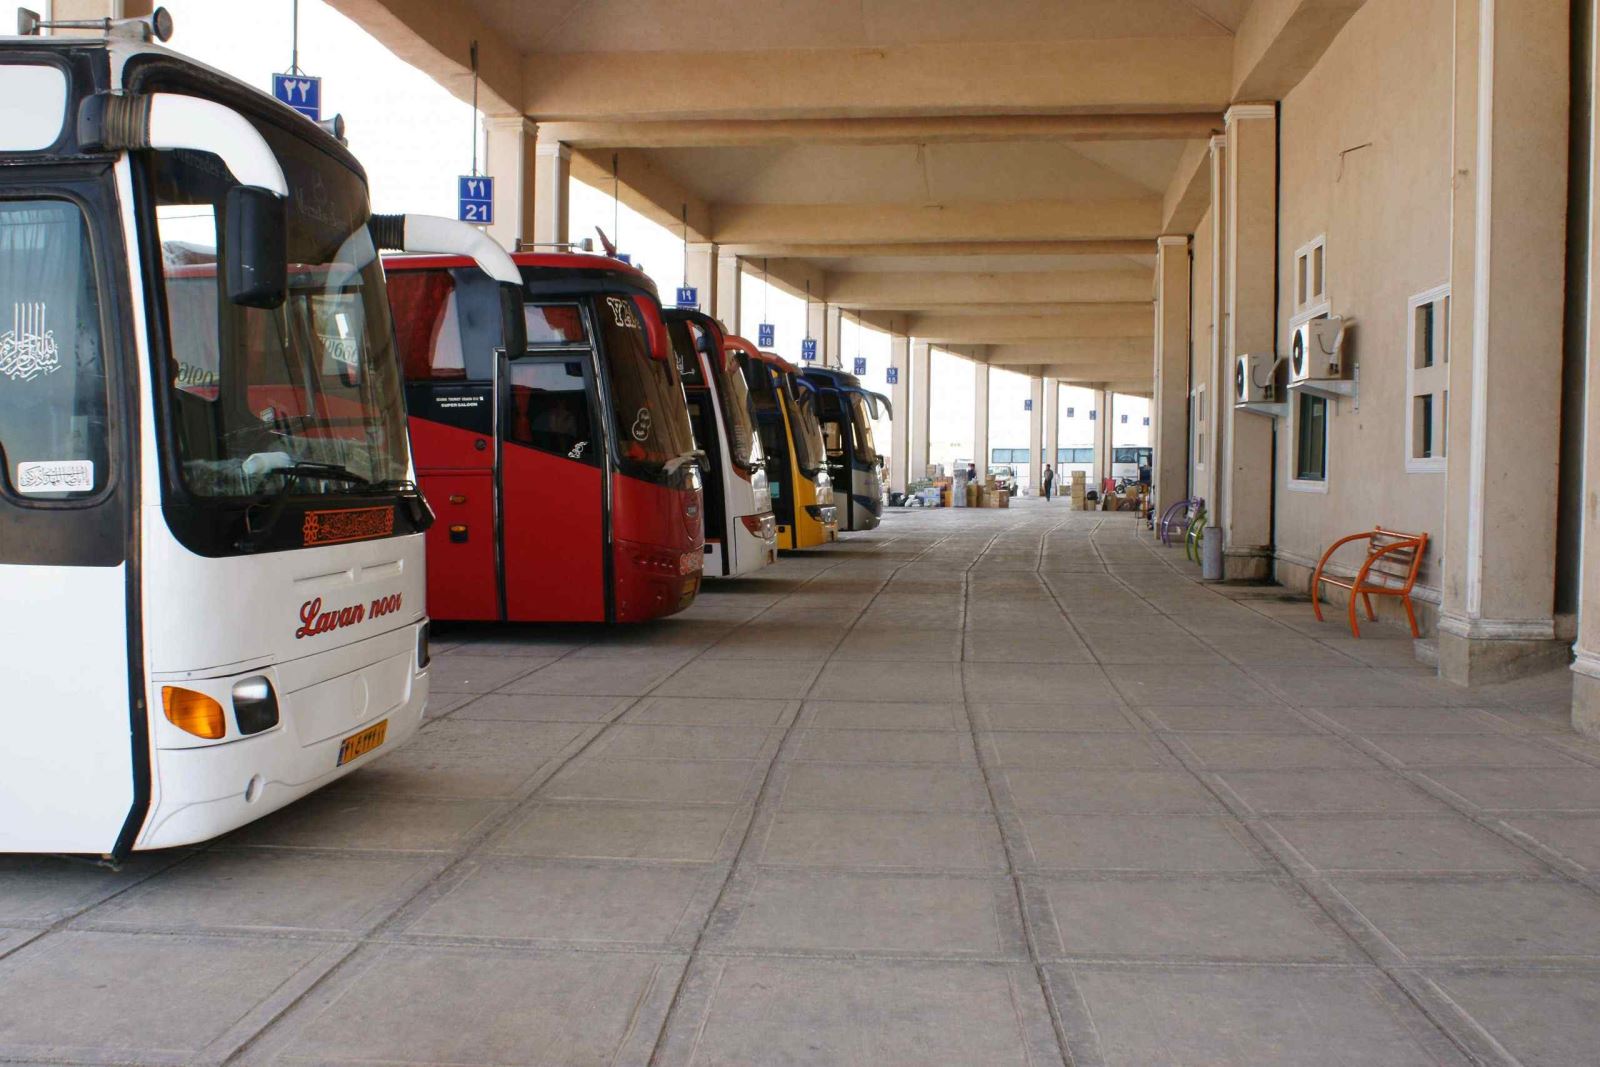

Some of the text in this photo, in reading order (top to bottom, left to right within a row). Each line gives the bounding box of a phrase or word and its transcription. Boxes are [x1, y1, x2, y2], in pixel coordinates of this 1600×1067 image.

[465, 204, 487, 220] 21
[761, 337, 771, 346] 18
[803, 351, 813, 359] 17
[855, 367, 865, 375] 16
[295, 592, 402, 639] Lavan noor
